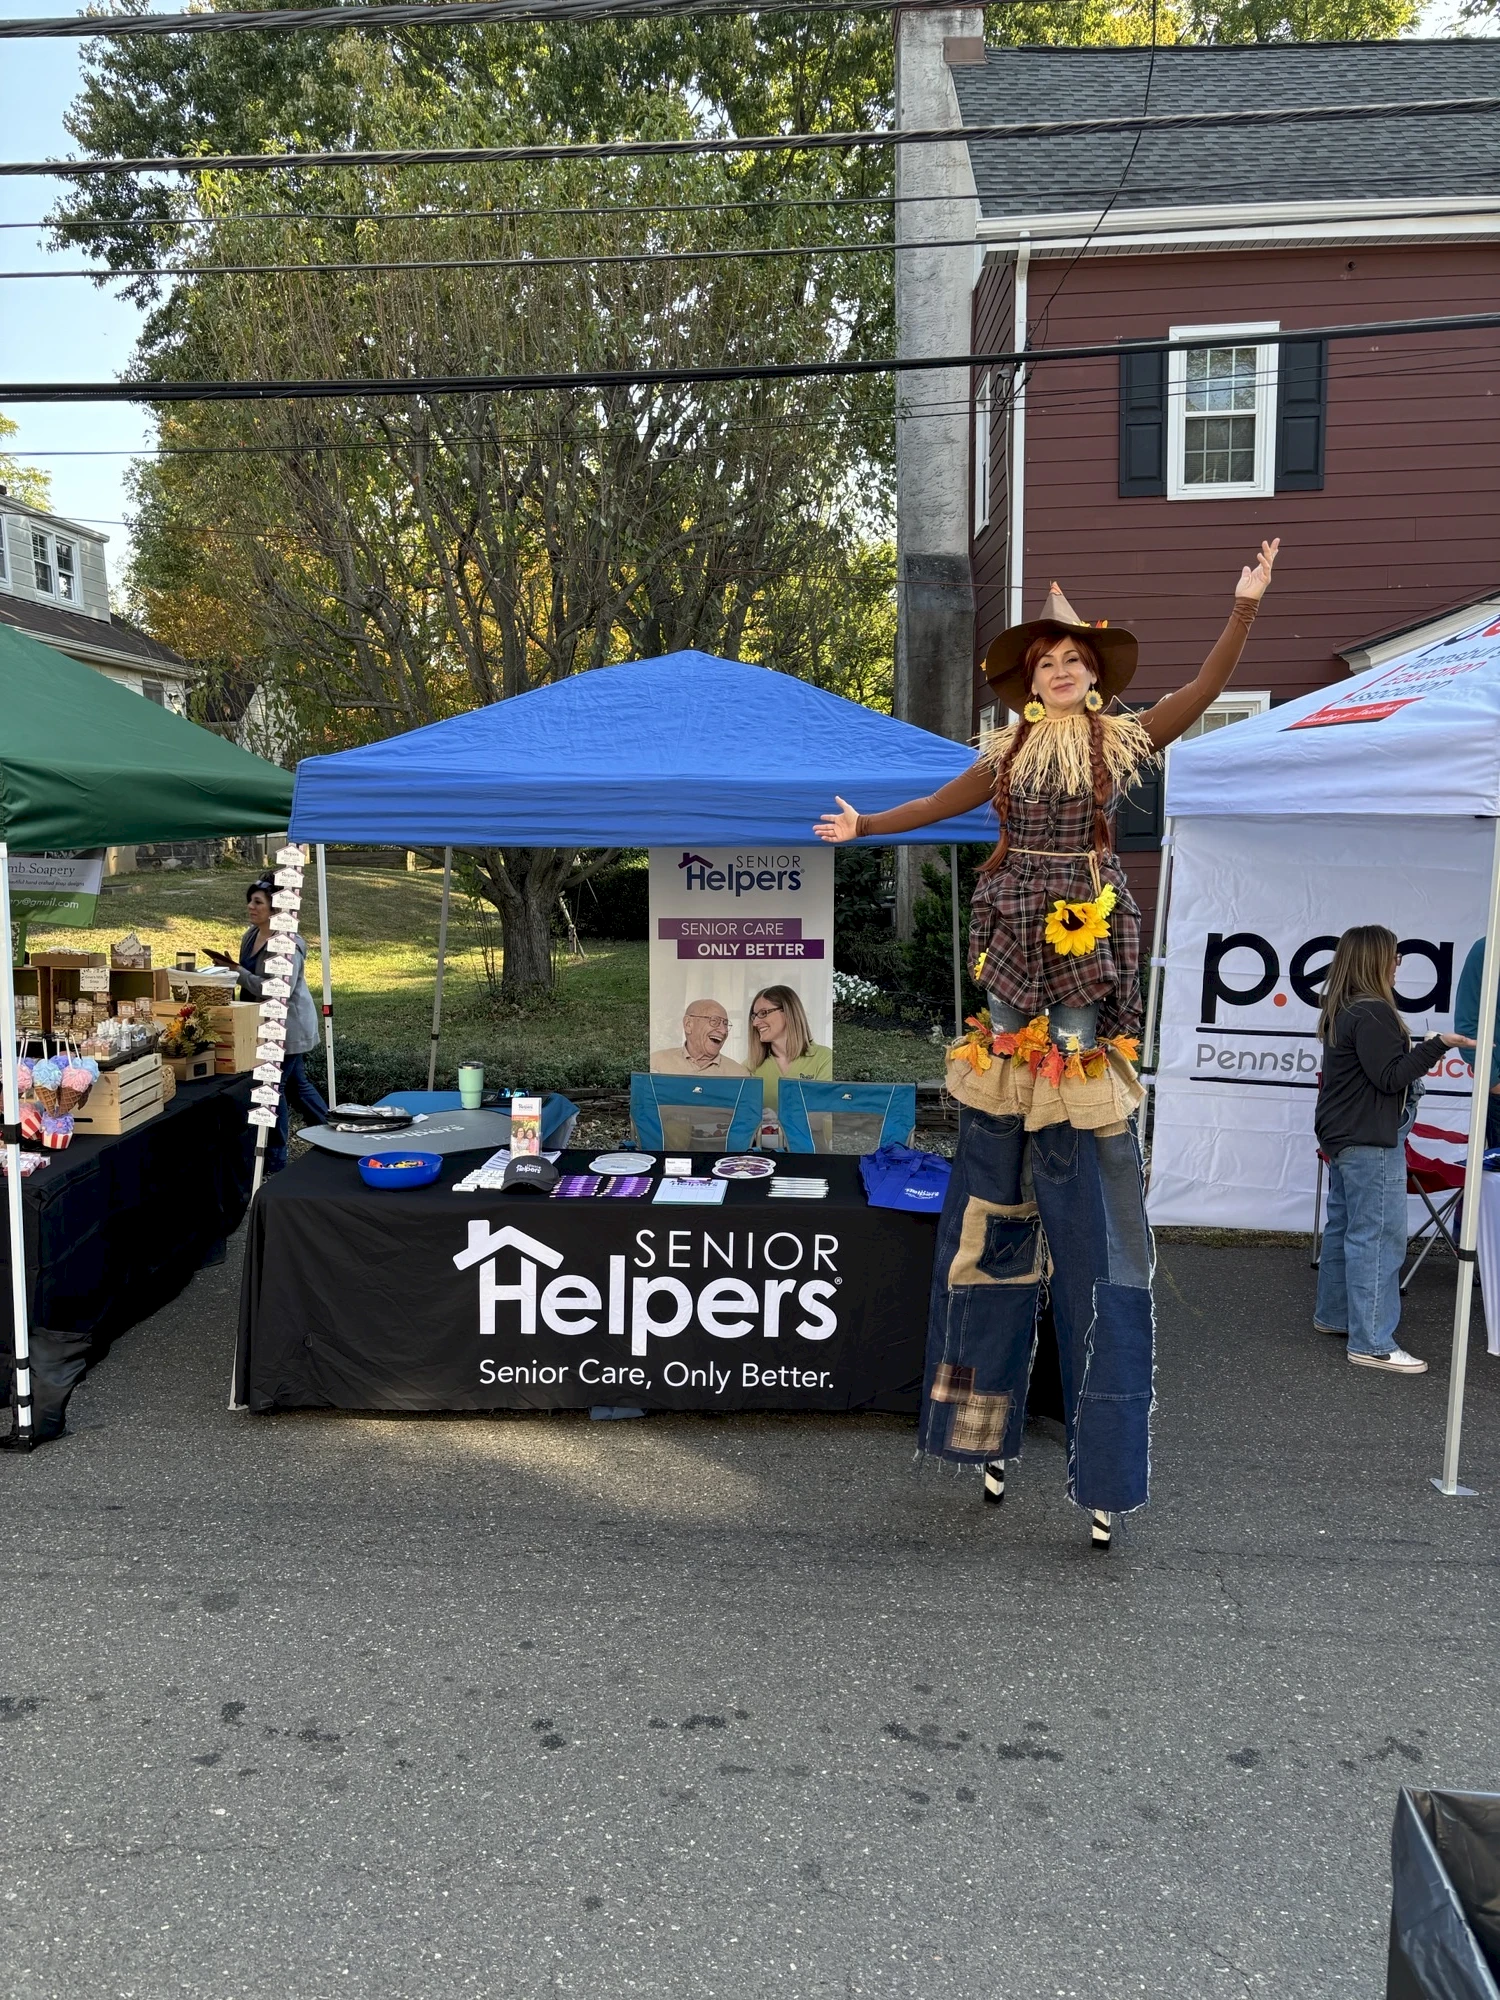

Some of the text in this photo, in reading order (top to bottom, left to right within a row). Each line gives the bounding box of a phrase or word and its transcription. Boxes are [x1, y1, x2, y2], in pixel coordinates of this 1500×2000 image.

[735, 855, 801, 869] SENIOR
[29, 862, 76, 878] Soapery
[681, 922, 784, 936] SENIOR CARE
[697, 943, 805, 957] ONLY BETTER
[633, 1229, 839, 1272] SENIOR
[479, 1358, 834, 1394] Senior Care, Only Better.
